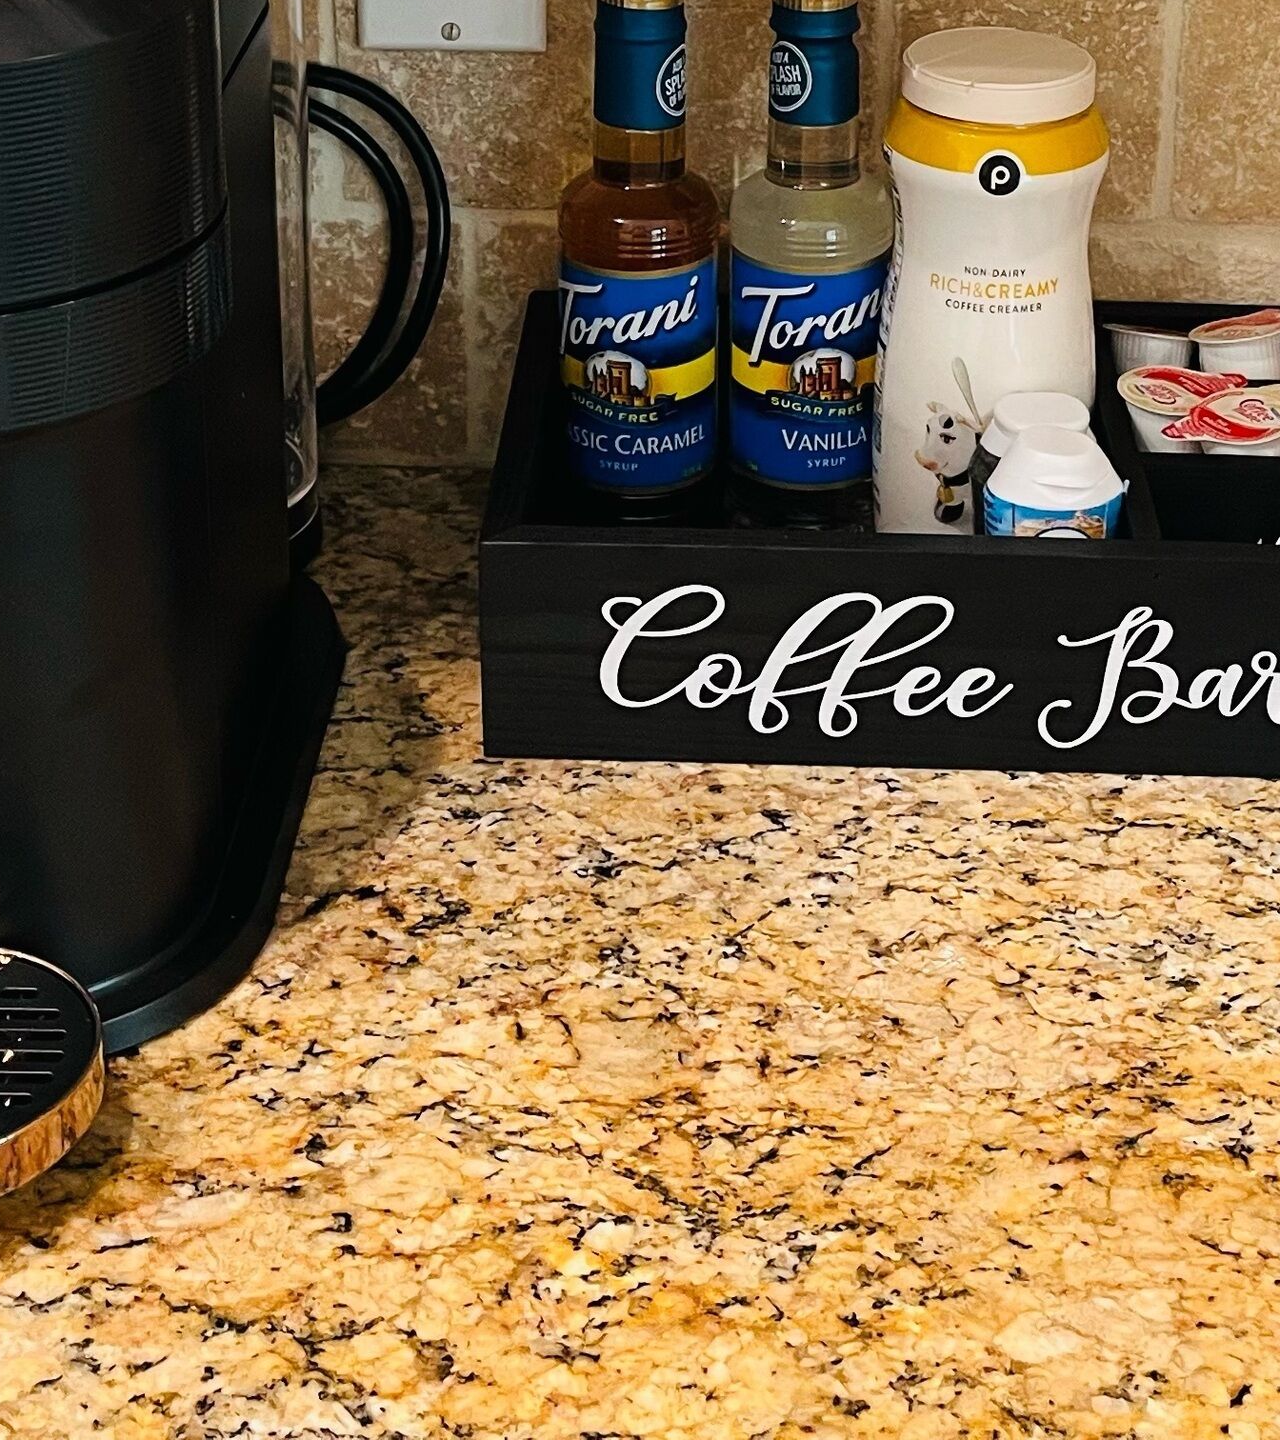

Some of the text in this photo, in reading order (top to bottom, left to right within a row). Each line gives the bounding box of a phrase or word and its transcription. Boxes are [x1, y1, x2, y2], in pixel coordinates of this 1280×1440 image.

[559, 275, 699, 355] Torani
[945, 298, 1042, 314] COFFEE CREAMER
[741, 282, 880, 367] Toran
[571, 392, 659, 423] SUGAR FREE
[770, 396, 864, 417] SUGAR FREE
[614, 423, 706, 456] CARAMEL
[782, 426, 868, 452] VANILLA
[599, 459, 639, 471] SYRUP
[807, 456, 847, 469] SYRUP
[599, 584, 1014, 738] Coffee
